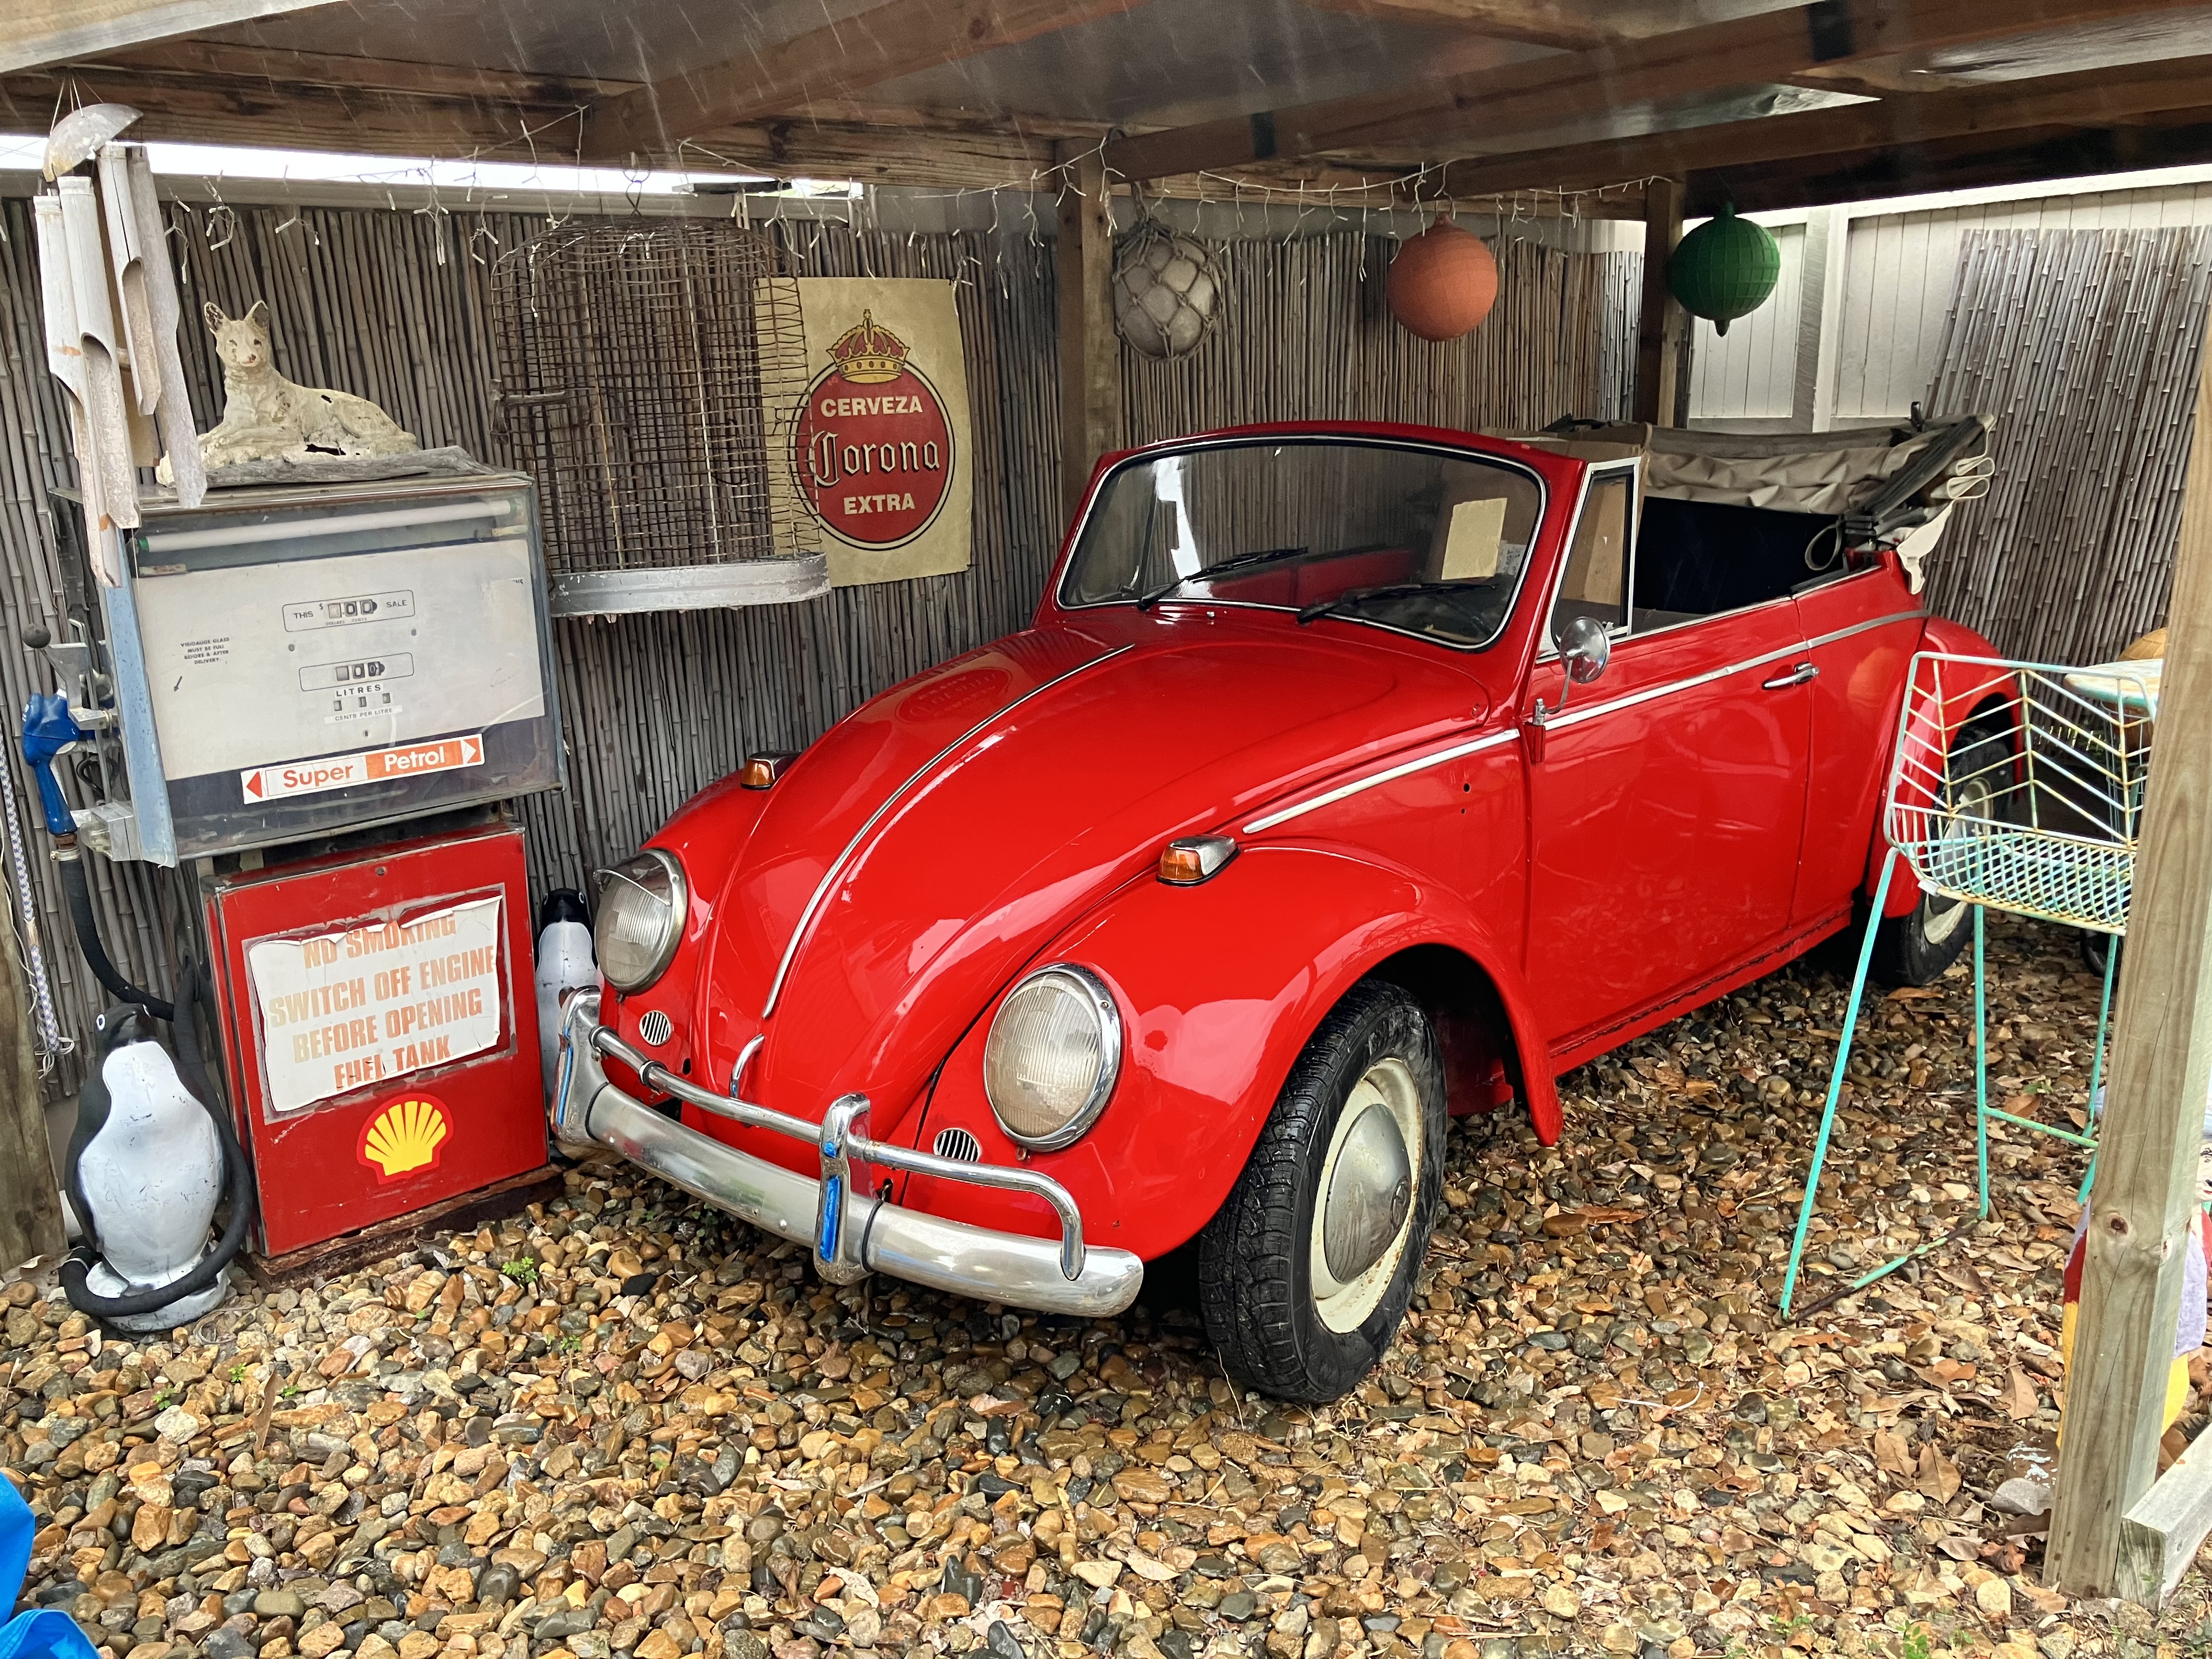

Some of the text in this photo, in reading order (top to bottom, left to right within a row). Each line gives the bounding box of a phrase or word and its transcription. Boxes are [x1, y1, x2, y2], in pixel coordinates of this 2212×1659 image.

[821, 396, 923, 417] CERVEZA
[808, 430, 940, 487] Corona
[844, 493, 916, 515] EXTRA
[294, 611, 313, 619] THIS
[386, 600, 407, 608] SALE
[336, 684, 381, 697] LITRES
[284, 747, 445, 787] Super Petrol
[303, 937, 338, 969] NO
[269, 945, 495, 1028] SWITCH OFF ENGINE
[292, 988, 483, 1064] BEFORE OPENING
[334, 1034, 452, 1091] FUEL TANK
